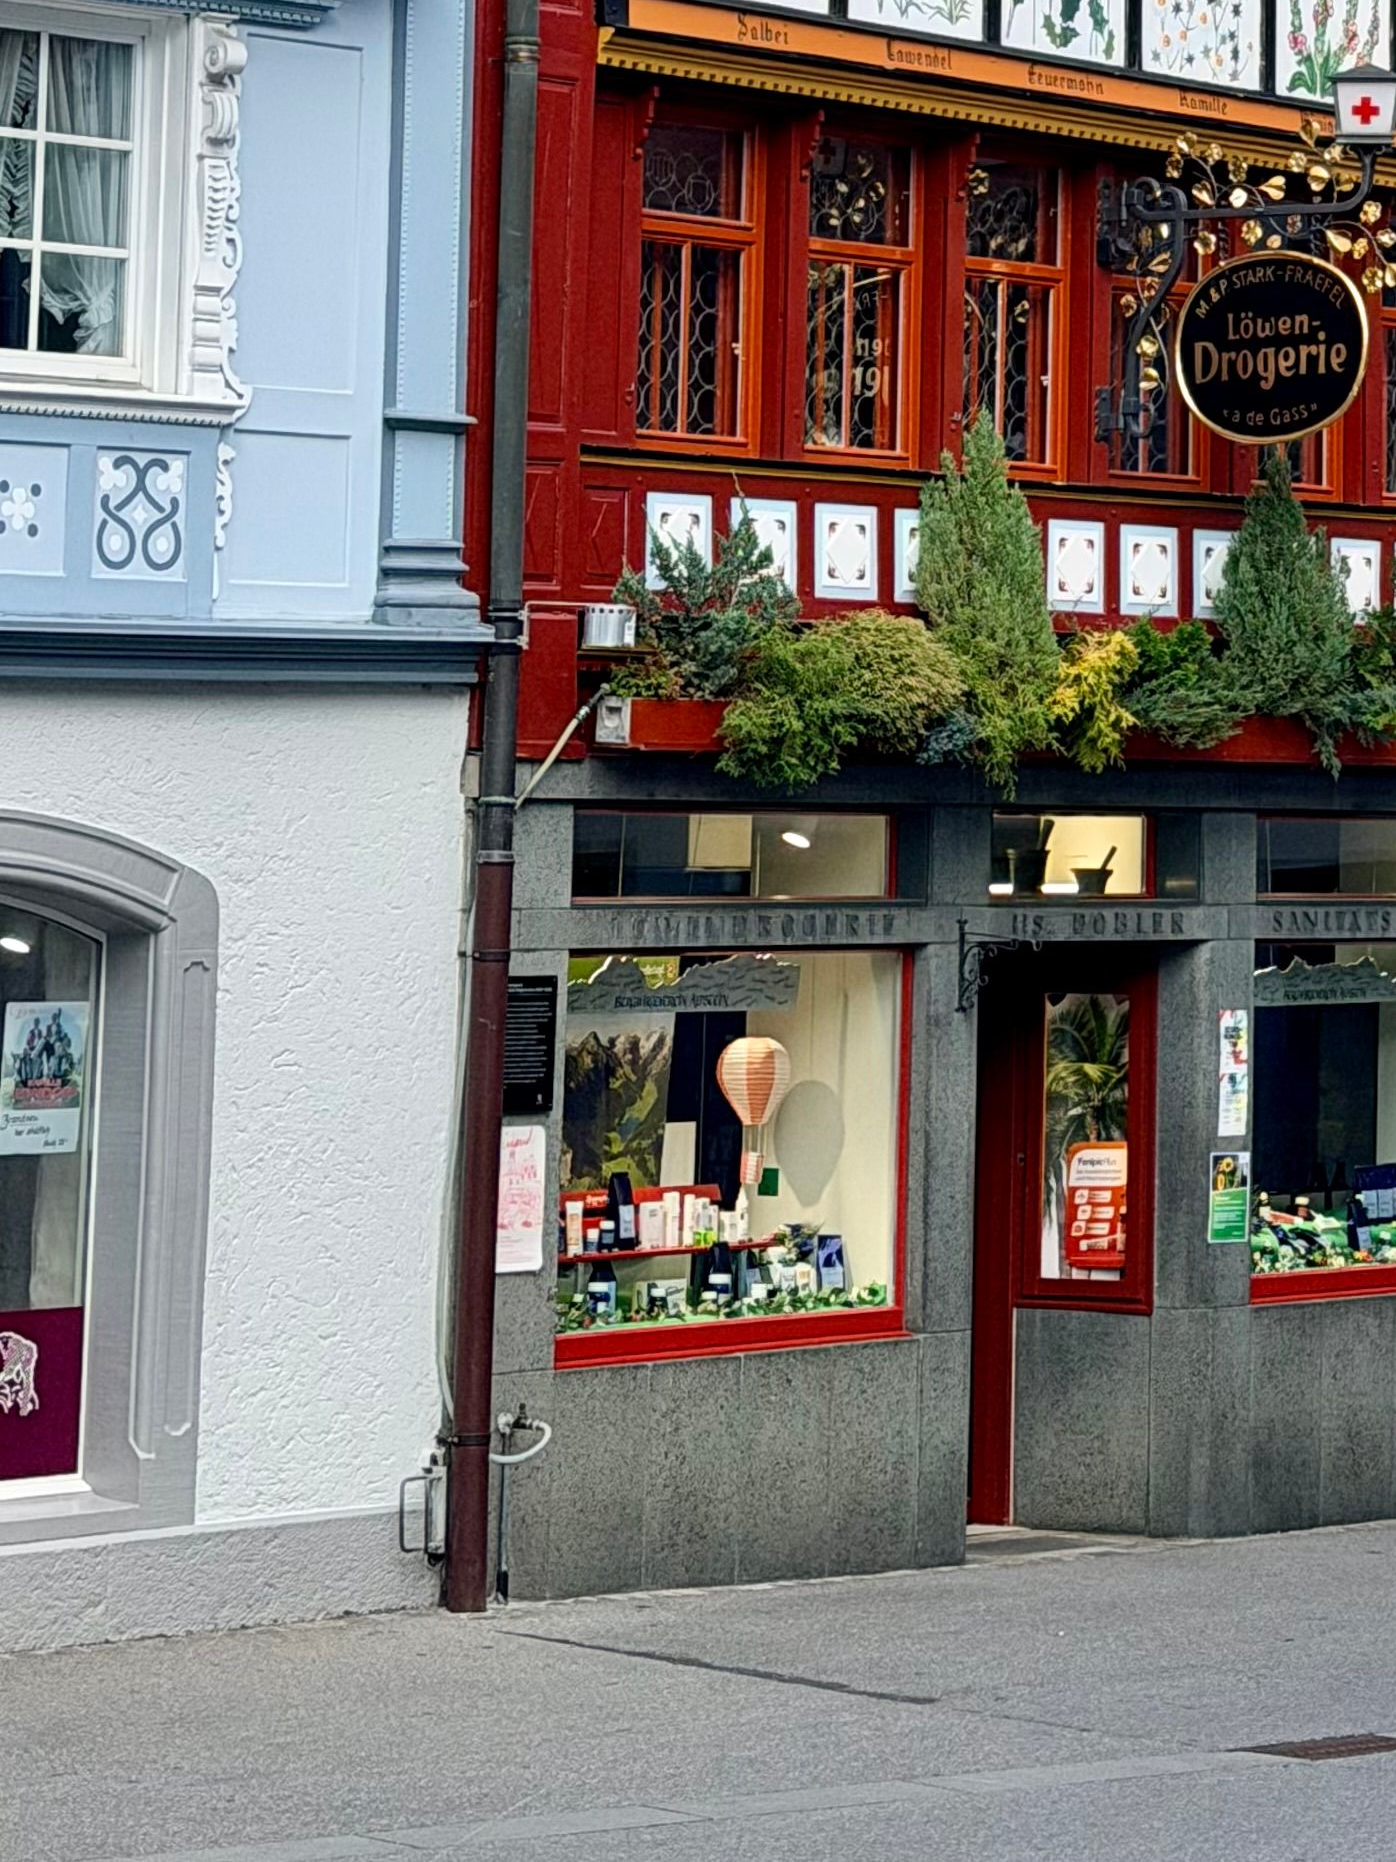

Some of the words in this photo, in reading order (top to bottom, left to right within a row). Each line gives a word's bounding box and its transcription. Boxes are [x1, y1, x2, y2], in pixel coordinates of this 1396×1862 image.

[737, 12, 788, 45] Salbei
[1179, 89, 1228, 115] Kamille
[1232, 265, 1346, 310] STARK-FRAEFEL
[1227, 311, 1321, 340] Löwen-
[1194, 331, 1347, 390] Drogerie
[1246, 411, 1264, 426] de
[1072, 912, 1184, 935] DOBLER
